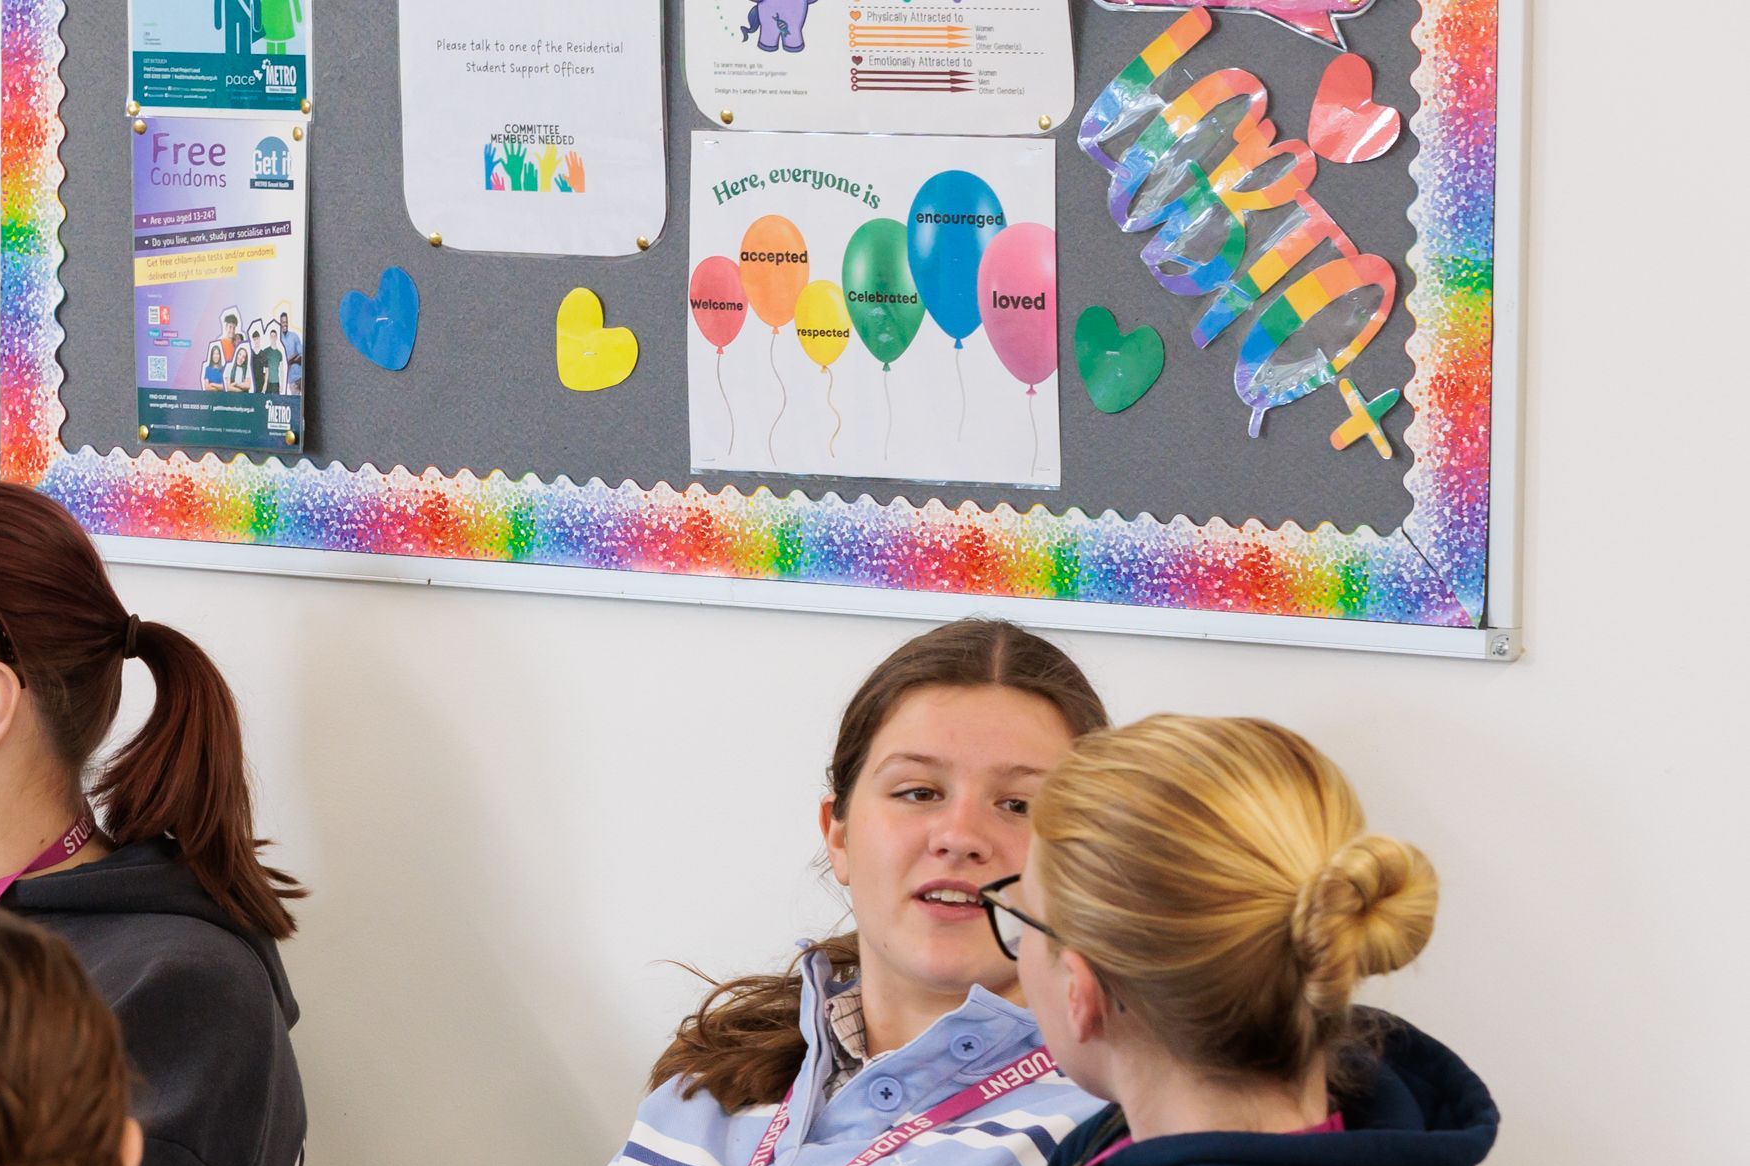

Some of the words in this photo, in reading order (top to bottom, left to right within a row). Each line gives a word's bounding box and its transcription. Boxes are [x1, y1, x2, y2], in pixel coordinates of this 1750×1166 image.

[867, 11, 908, 24] Physically
[910, 11, 951, 23] Attracted
[954, 13, 964, 23] to
[436, 39, 467, 51] Please
[470, 40, 491, 52] talk
[494, 40, 505, 52] to
[509, 44, 527, 52] one
[530, 40, 542, 55] of
[545, 41, 562, 52] the
[566, 42, 624, 54] Residential
[466, 60, 506, 74] Student
[510, 62, 550, 78] Support
[554, 61, 595, 78] Officers
[868, 55, 916, 68] Emotionally
[918, 56, 960, 67] Attracted
[963, 58, 973, 67] to
[226, 74, 256, 87] pace
[266, 65, 297, 86] METRO
[504, 124, 560, 135] COMMITTEE
[490, 134, 536, 144] MEMBERS
[538, 135, 574, 145] NEEDED
[152, 132, 226, 166] Free
[252, 149, 278, 176] Get
[282, 150, 292, 176] it
[150, 167, 227, 188] Condoms
[712, 173, 767, 206] Here,
[769, 167, 861, 199] everyone
[858, 184, 882, 210] is
[150, 216, 162, 225] Are
[162, 216, 175, 226] you
[176, 213, 192, 225] aged
[193, 210, 216, 221] 13-24?
[916, 211, 1004, 228] encouraged
[152, 238, 161, 247] Do
[162, 238, 175, 248] you
[176, 234, 189, 245] live,
[190, 233, 208, 243] work,
[210, 230, 228, 242] study
[237, 228, 263, 238] socialise
[264, 226, 271, 235] in
[272, 224, 290, 234] Kent?
[146, 258, 159, 268] Get
[160, 257, 173, 266] free
[174, 254, 206, 266] chlamydia
[208, 252, 223, 262] tests
[225, 250, 246, 259] and/or
[246, 247, 274, 258] condoms
[740, 249, 808, 266] accepted
[148, 270, 177, 281] delivered
[178, 269, 195, 280] right
[220, 266, 234, 274] door
[690, 298, 744, 311] Welcome
[848, 290, 918, 305] Celebrated
[992, 290, 1046, 310] loved
[796, 326, 850, 340] respected
[268, 405, 292, 424] METRO
[978, 1052, 1058, 1100] UDENT
